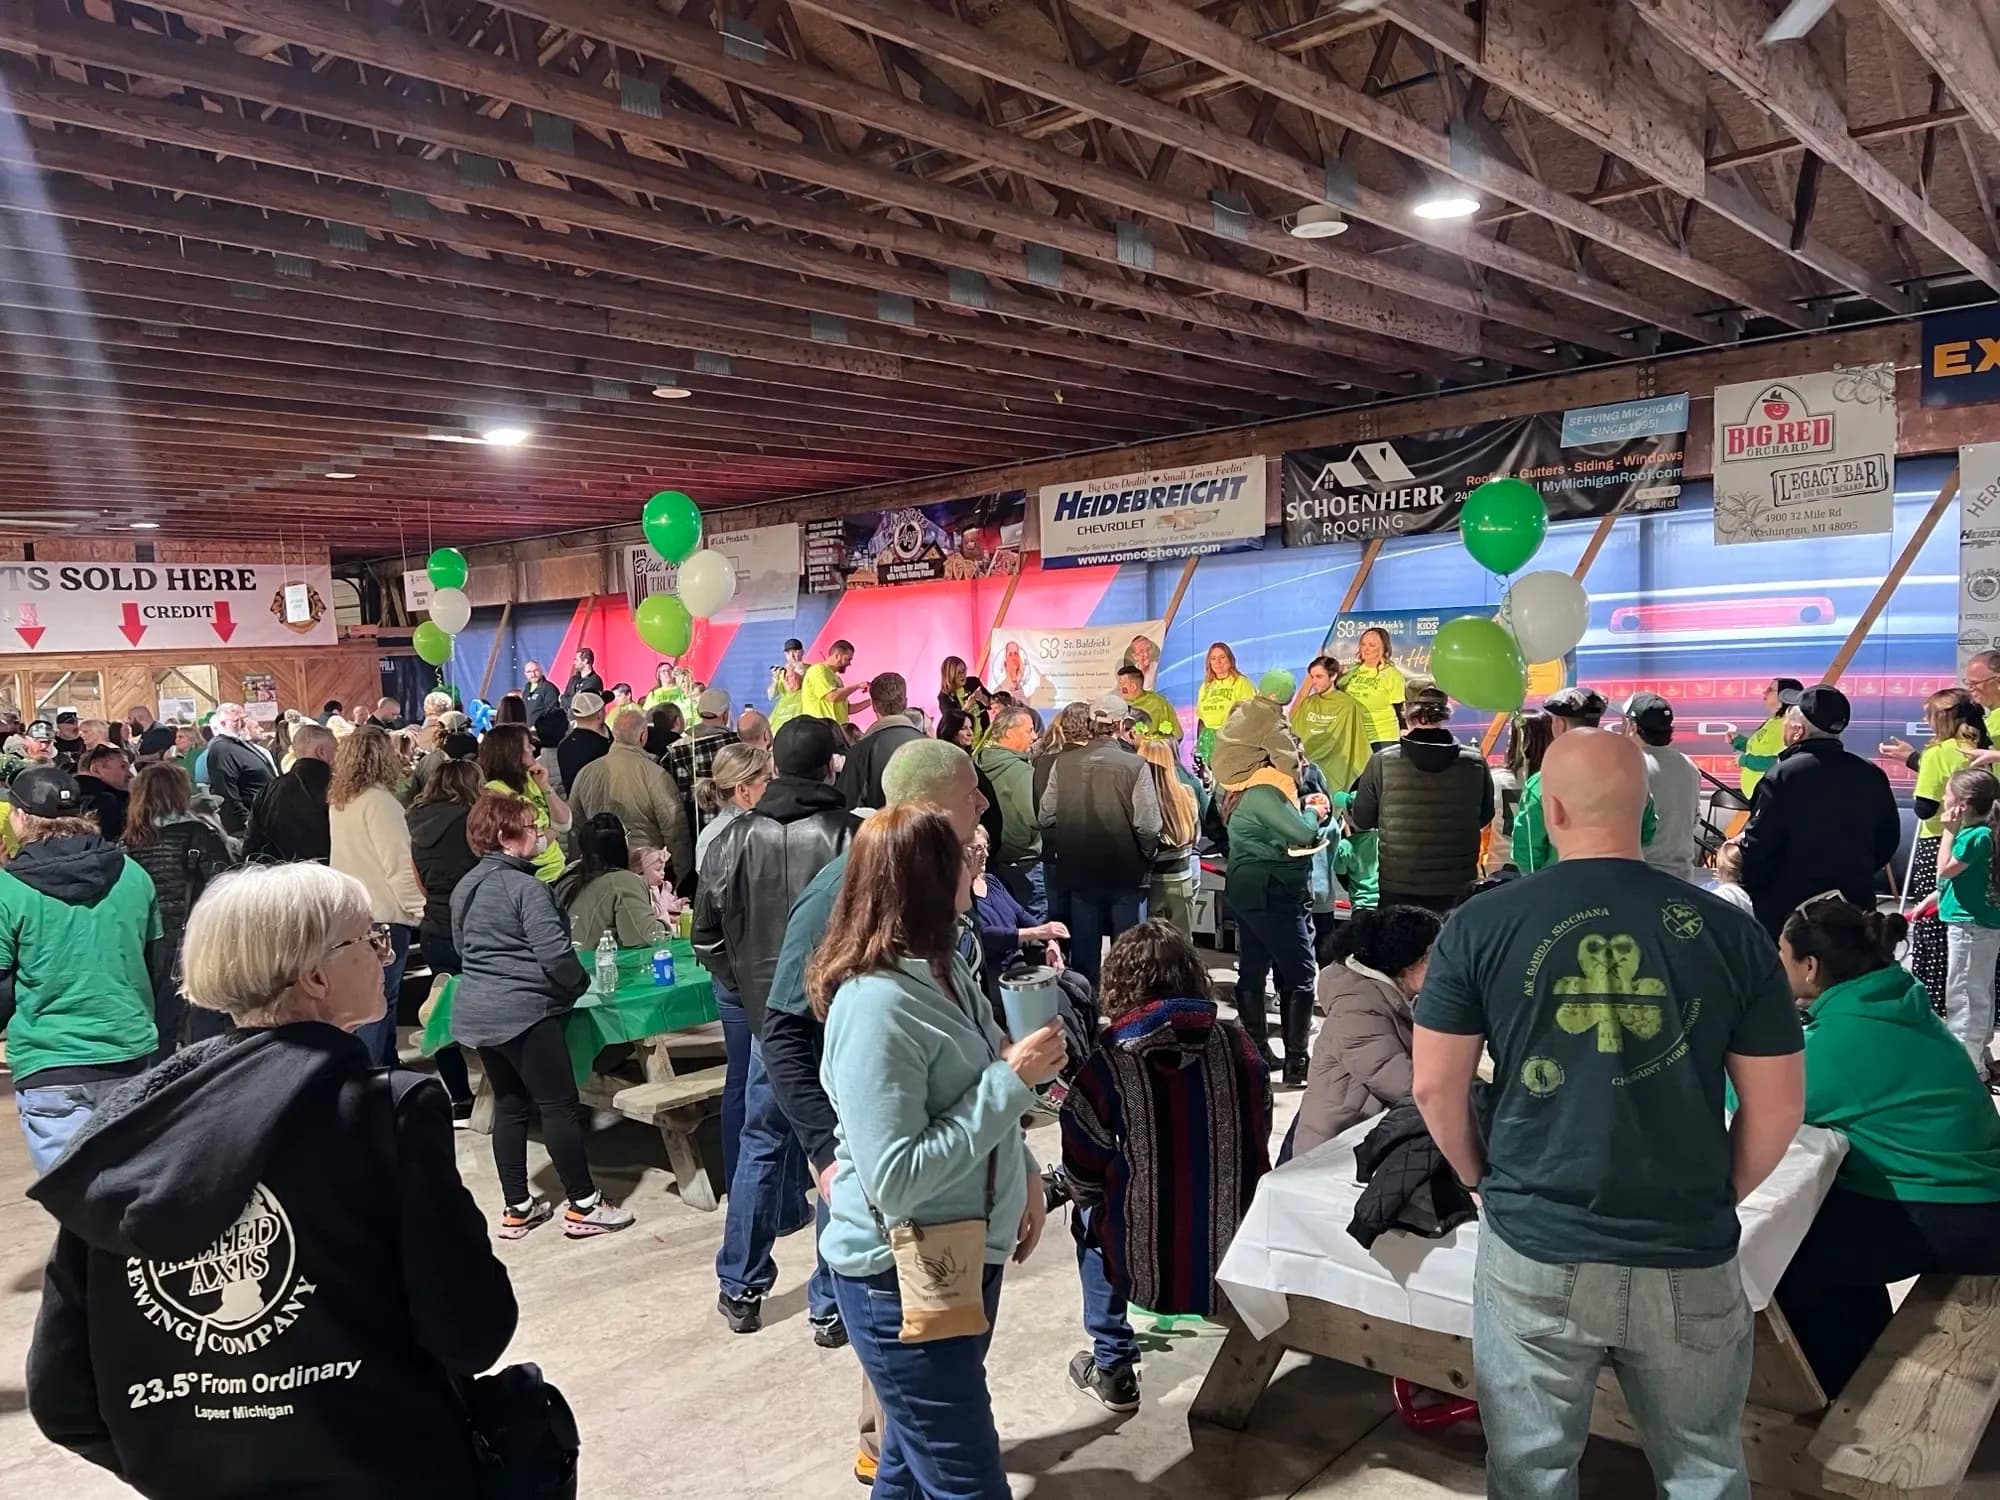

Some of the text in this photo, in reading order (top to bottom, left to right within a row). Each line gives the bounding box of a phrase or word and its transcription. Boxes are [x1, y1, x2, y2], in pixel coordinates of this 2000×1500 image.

[1568, 402, 1684, 426] SERVING MICHIGAN
[1591, 423, 1627, 437] SINCE
[1728, 418, 1830, 455] BIG RED
[1747, 443, 1809, 457] ORCHARD
[1519, 465, 1565, 480] Gutters
[1574, 457, 1615, 473] Siding
[1623, 450, 1683, 467] Windows
[1088, 482, 1101, 494] Big
[1102, 479, 1119, 491] City
[1162, 470, 1186, 482] Small
[1190, 468, 1213, 480] Town
[1779, 460, 1879, 500] LEGACY BAR
[1831, 482, 1864, 495] ORCHARD
[1054, 475, 1248, 522] HEIDEBREICHT
[1286, 485, 1445, 522] SCHOENHERR
[1323, 515, 1404, 537] ROOFING
[1765, 507, 1842, 523] 4900 32 Mile Rd
[1077, 518, 1146, 536] CHEVROLET
[1812, 524, 1825, 533] MI
[1828, 521, 1858, 531] 48095
[726, 533, 750, 544] Products
[1077, 544, 1221, 566] www.romeochevy.com
[634, 558, 662, 576] Blue
[60, 567, 157, 591] SOLD
[166, 568, 257, 591] HERE
[143, 604, 214, 619] CREDIT
[1063, 639, 1074, 649] St.
[189, 1245, 270, 1296] AXIS
[207, 1275, 318, 1356] COMPANY
[127, 1359, 363, 1409] 23.5° From Ordinary
[194, 1404, 294, 1421] Lapeer Michigan
